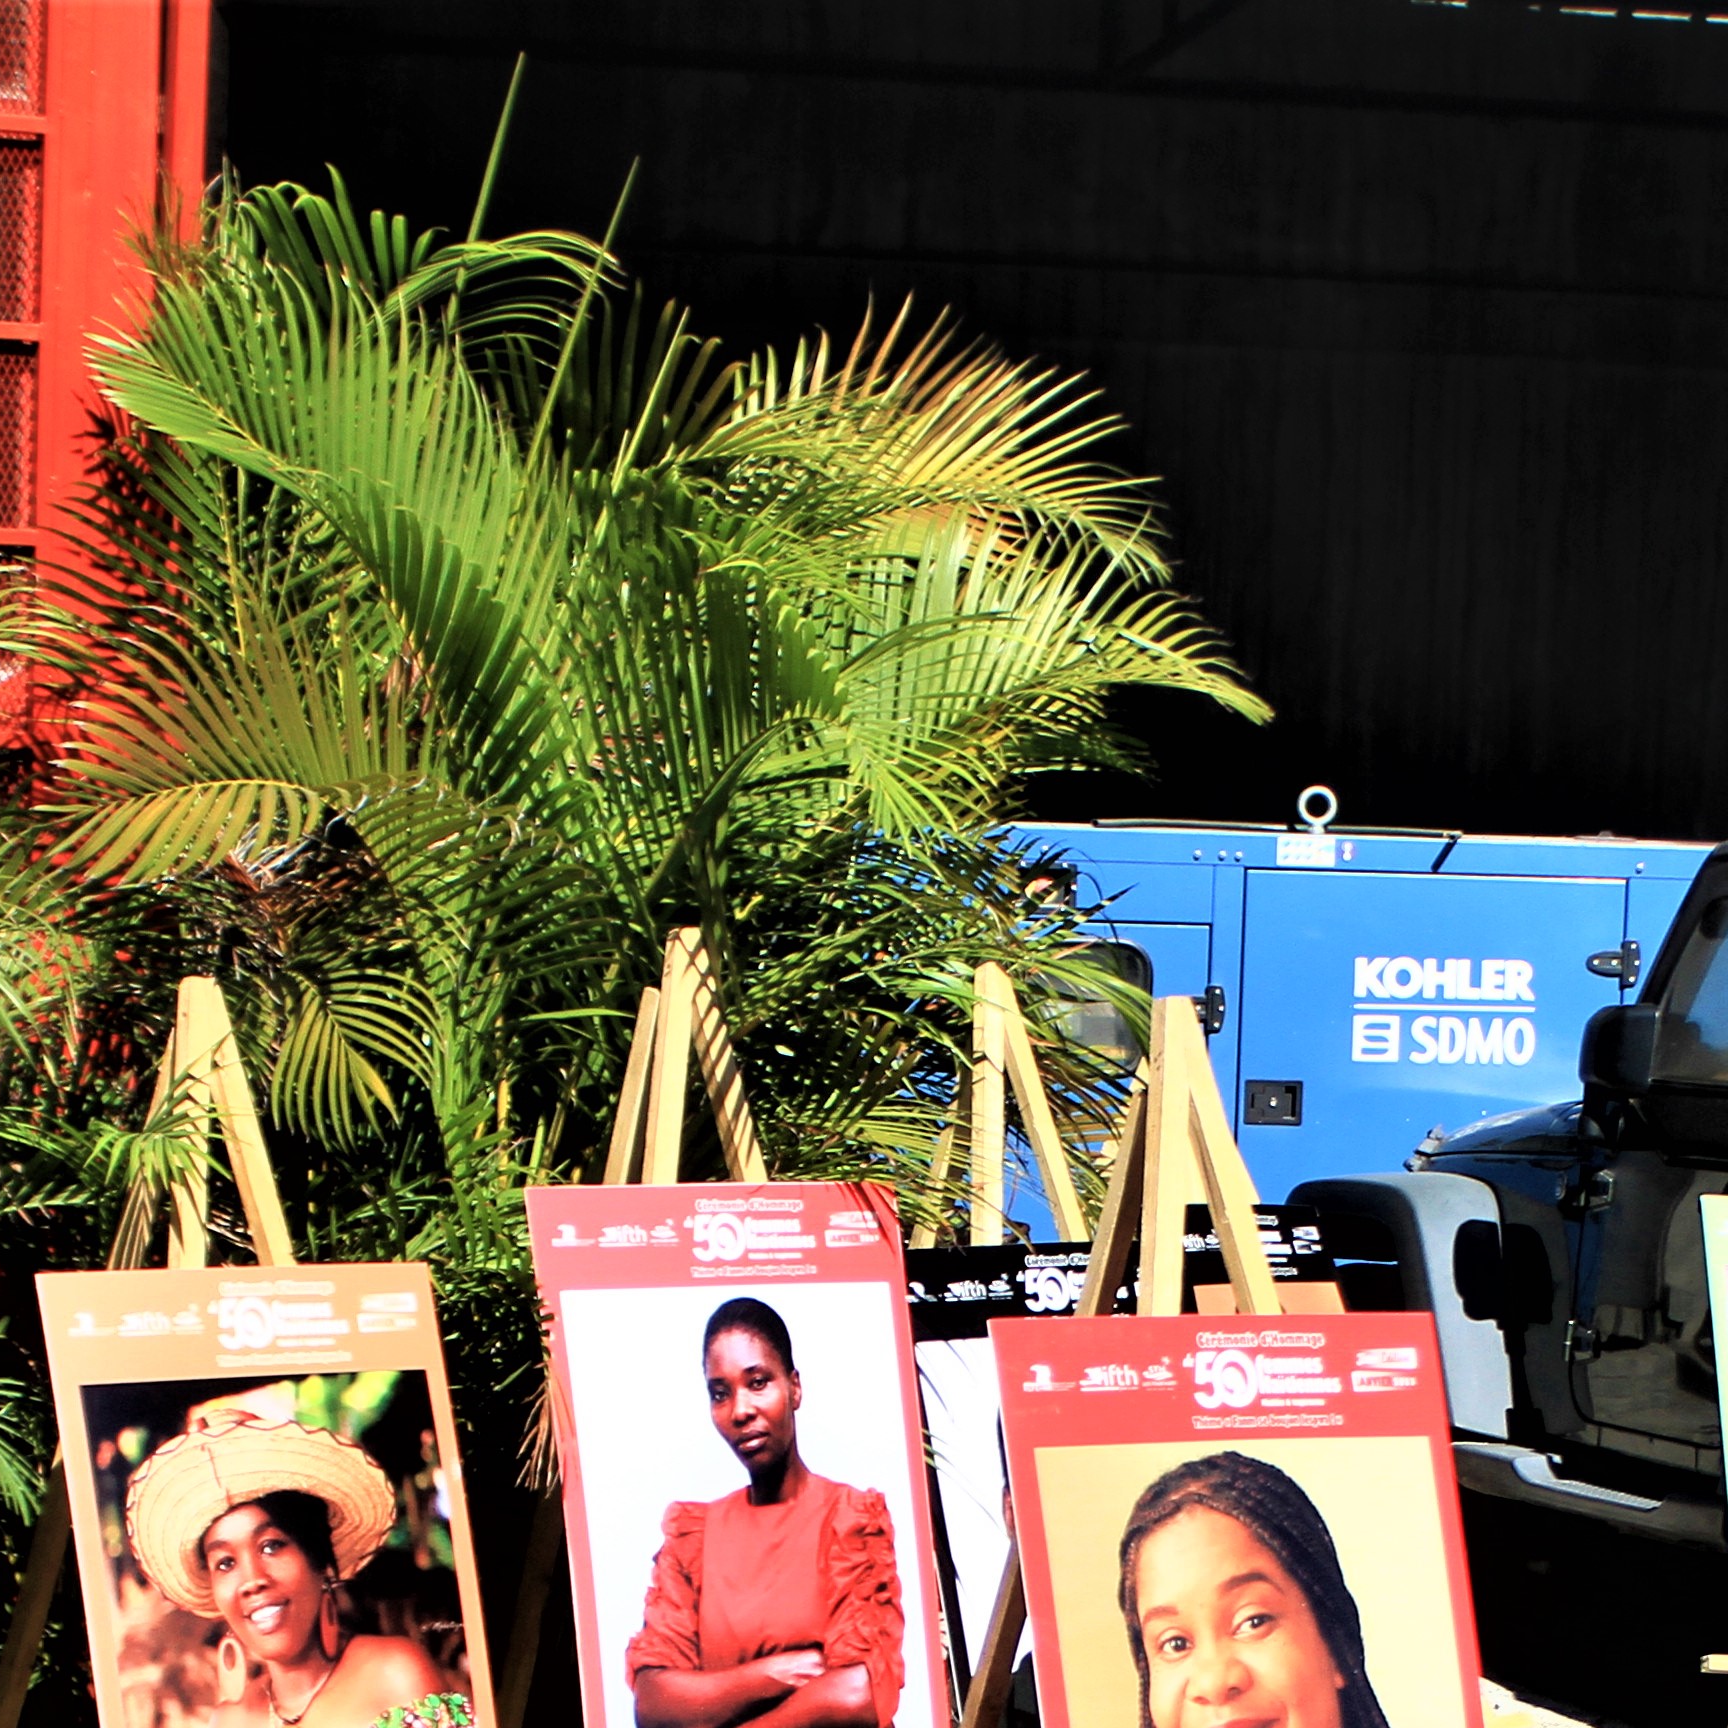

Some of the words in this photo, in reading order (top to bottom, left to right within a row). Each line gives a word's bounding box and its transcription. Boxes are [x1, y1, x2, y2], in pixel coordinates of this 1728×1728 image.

[1354, 957, 1535, 1001] KOHLER
[1409, 1016, 1535, 1065] SDMO
[1193, 1350, 1258, 1408] 50
